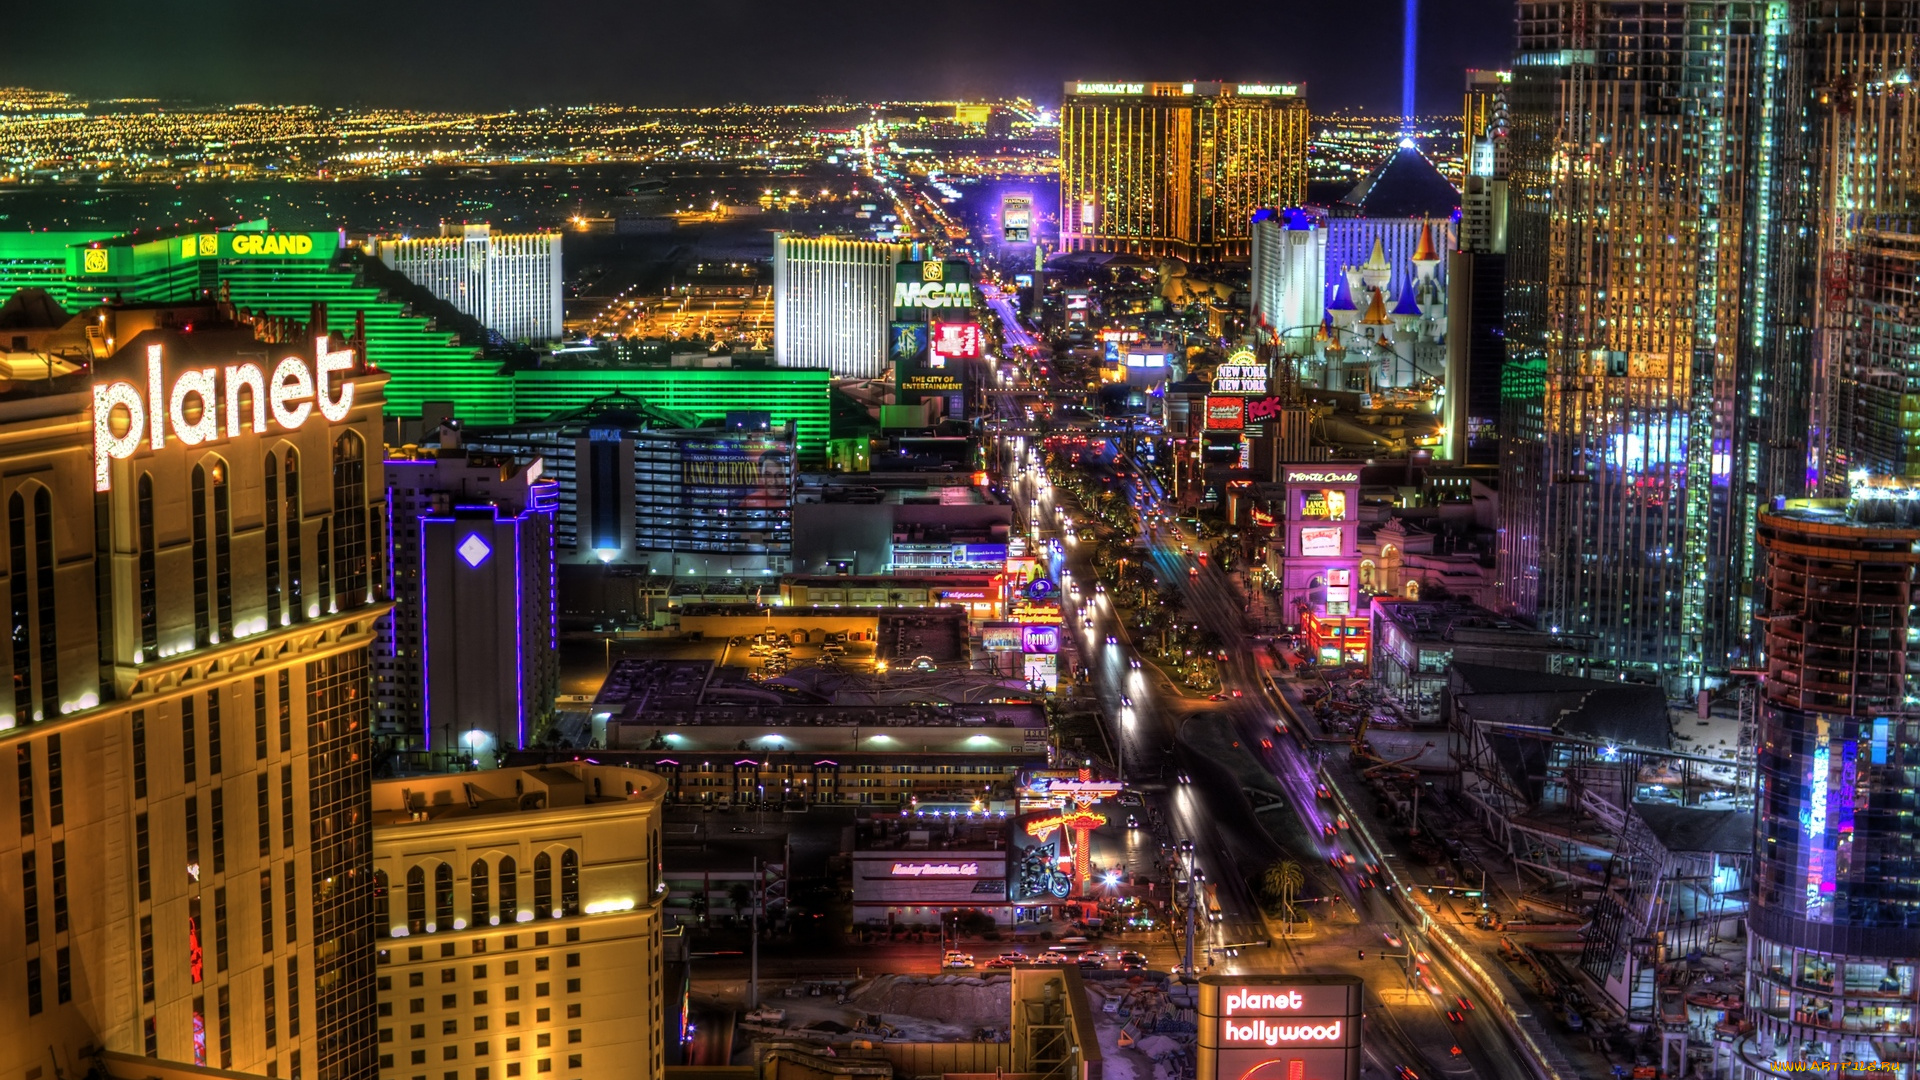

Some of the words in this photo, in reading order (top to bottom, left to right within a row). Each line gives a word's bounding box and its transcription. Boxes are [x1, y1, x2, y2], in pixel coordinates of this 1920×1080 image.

[1077, 84, 1126, 94] MANDALAY
[1127, 84, 1144, 94] BAY
[1237, 85, 1281, 95] MANDALAY
[1282, 86, 1297, 95] BAY
[232, 235, 312, 254] GRAND
[894, 282, 972, 308] MGM
[1219, 366, 1240, 378] NEW
[1241, 366, 1267, 378] YORK
[1218, 380, 1240, 391] NEW
[1241, 380, 1267, 391] YORK
[92, 336, 354, 492] planet
[683, 461, 715, 485] LANCE
[718, 461, 760, 485] BURTON
[1288, 472, 1324, 482] Monte
[1324, 472, 1358, 482] Carlo
[1302, 507, 1329, 516] BURTON
[1226, 988, 1303, 1015] planet
[1225, 1020, 1341, 1046] hollywood
